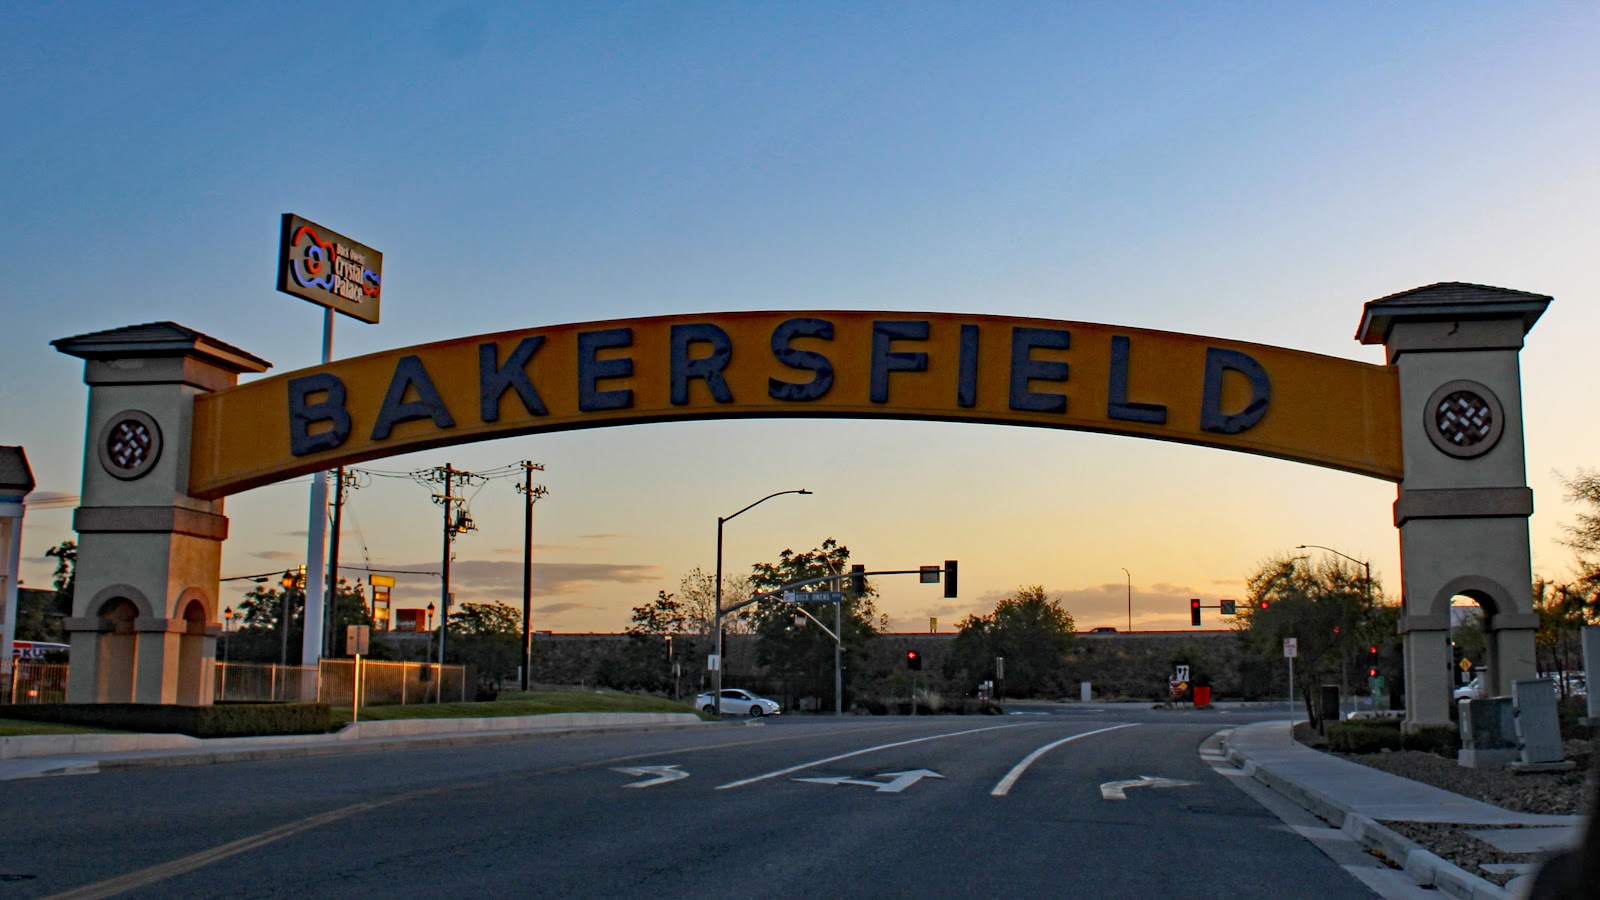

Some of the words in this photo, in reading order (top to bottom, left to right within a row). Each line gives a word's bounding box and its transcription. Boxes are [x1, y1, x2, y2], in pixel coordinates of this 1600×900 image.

[335, 256, 364, 284] Crystal
[334, 275, 362, 303] Palace
[287, 318, 1271, 456] BAKERSFIELD
